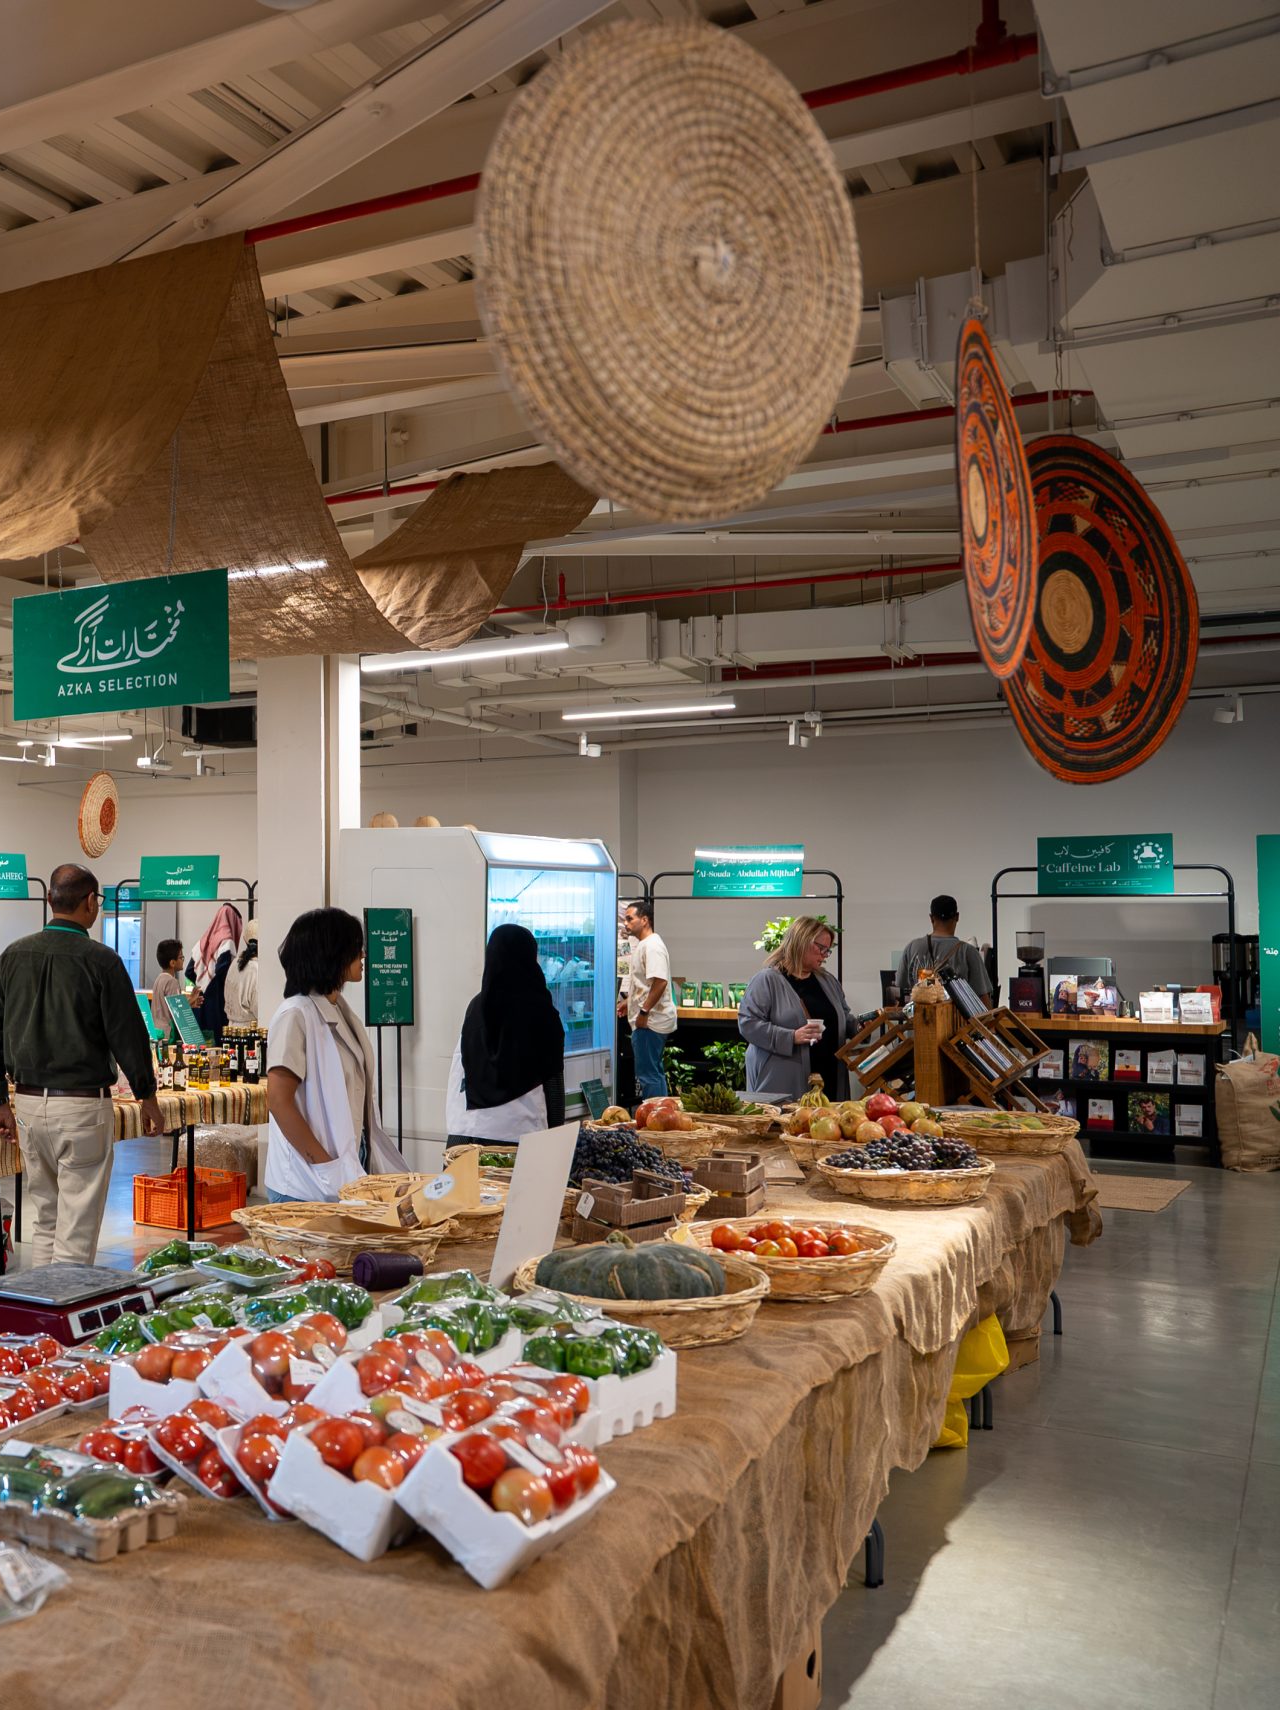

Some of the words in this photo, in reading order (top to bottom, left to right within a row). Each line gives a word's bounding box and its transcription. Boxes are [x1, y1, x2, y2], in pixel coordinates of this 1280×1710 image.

[57, 681, 93, 697] AZKA
[98, 672, 178, 692] SELECTION
[1046, 863, 1096, 873] Caffeine
[1098, 861, 1121, 872] Lab
[736, 869, 769, 878] Abdullah
[166, 878, 191, 886] Shadwi
